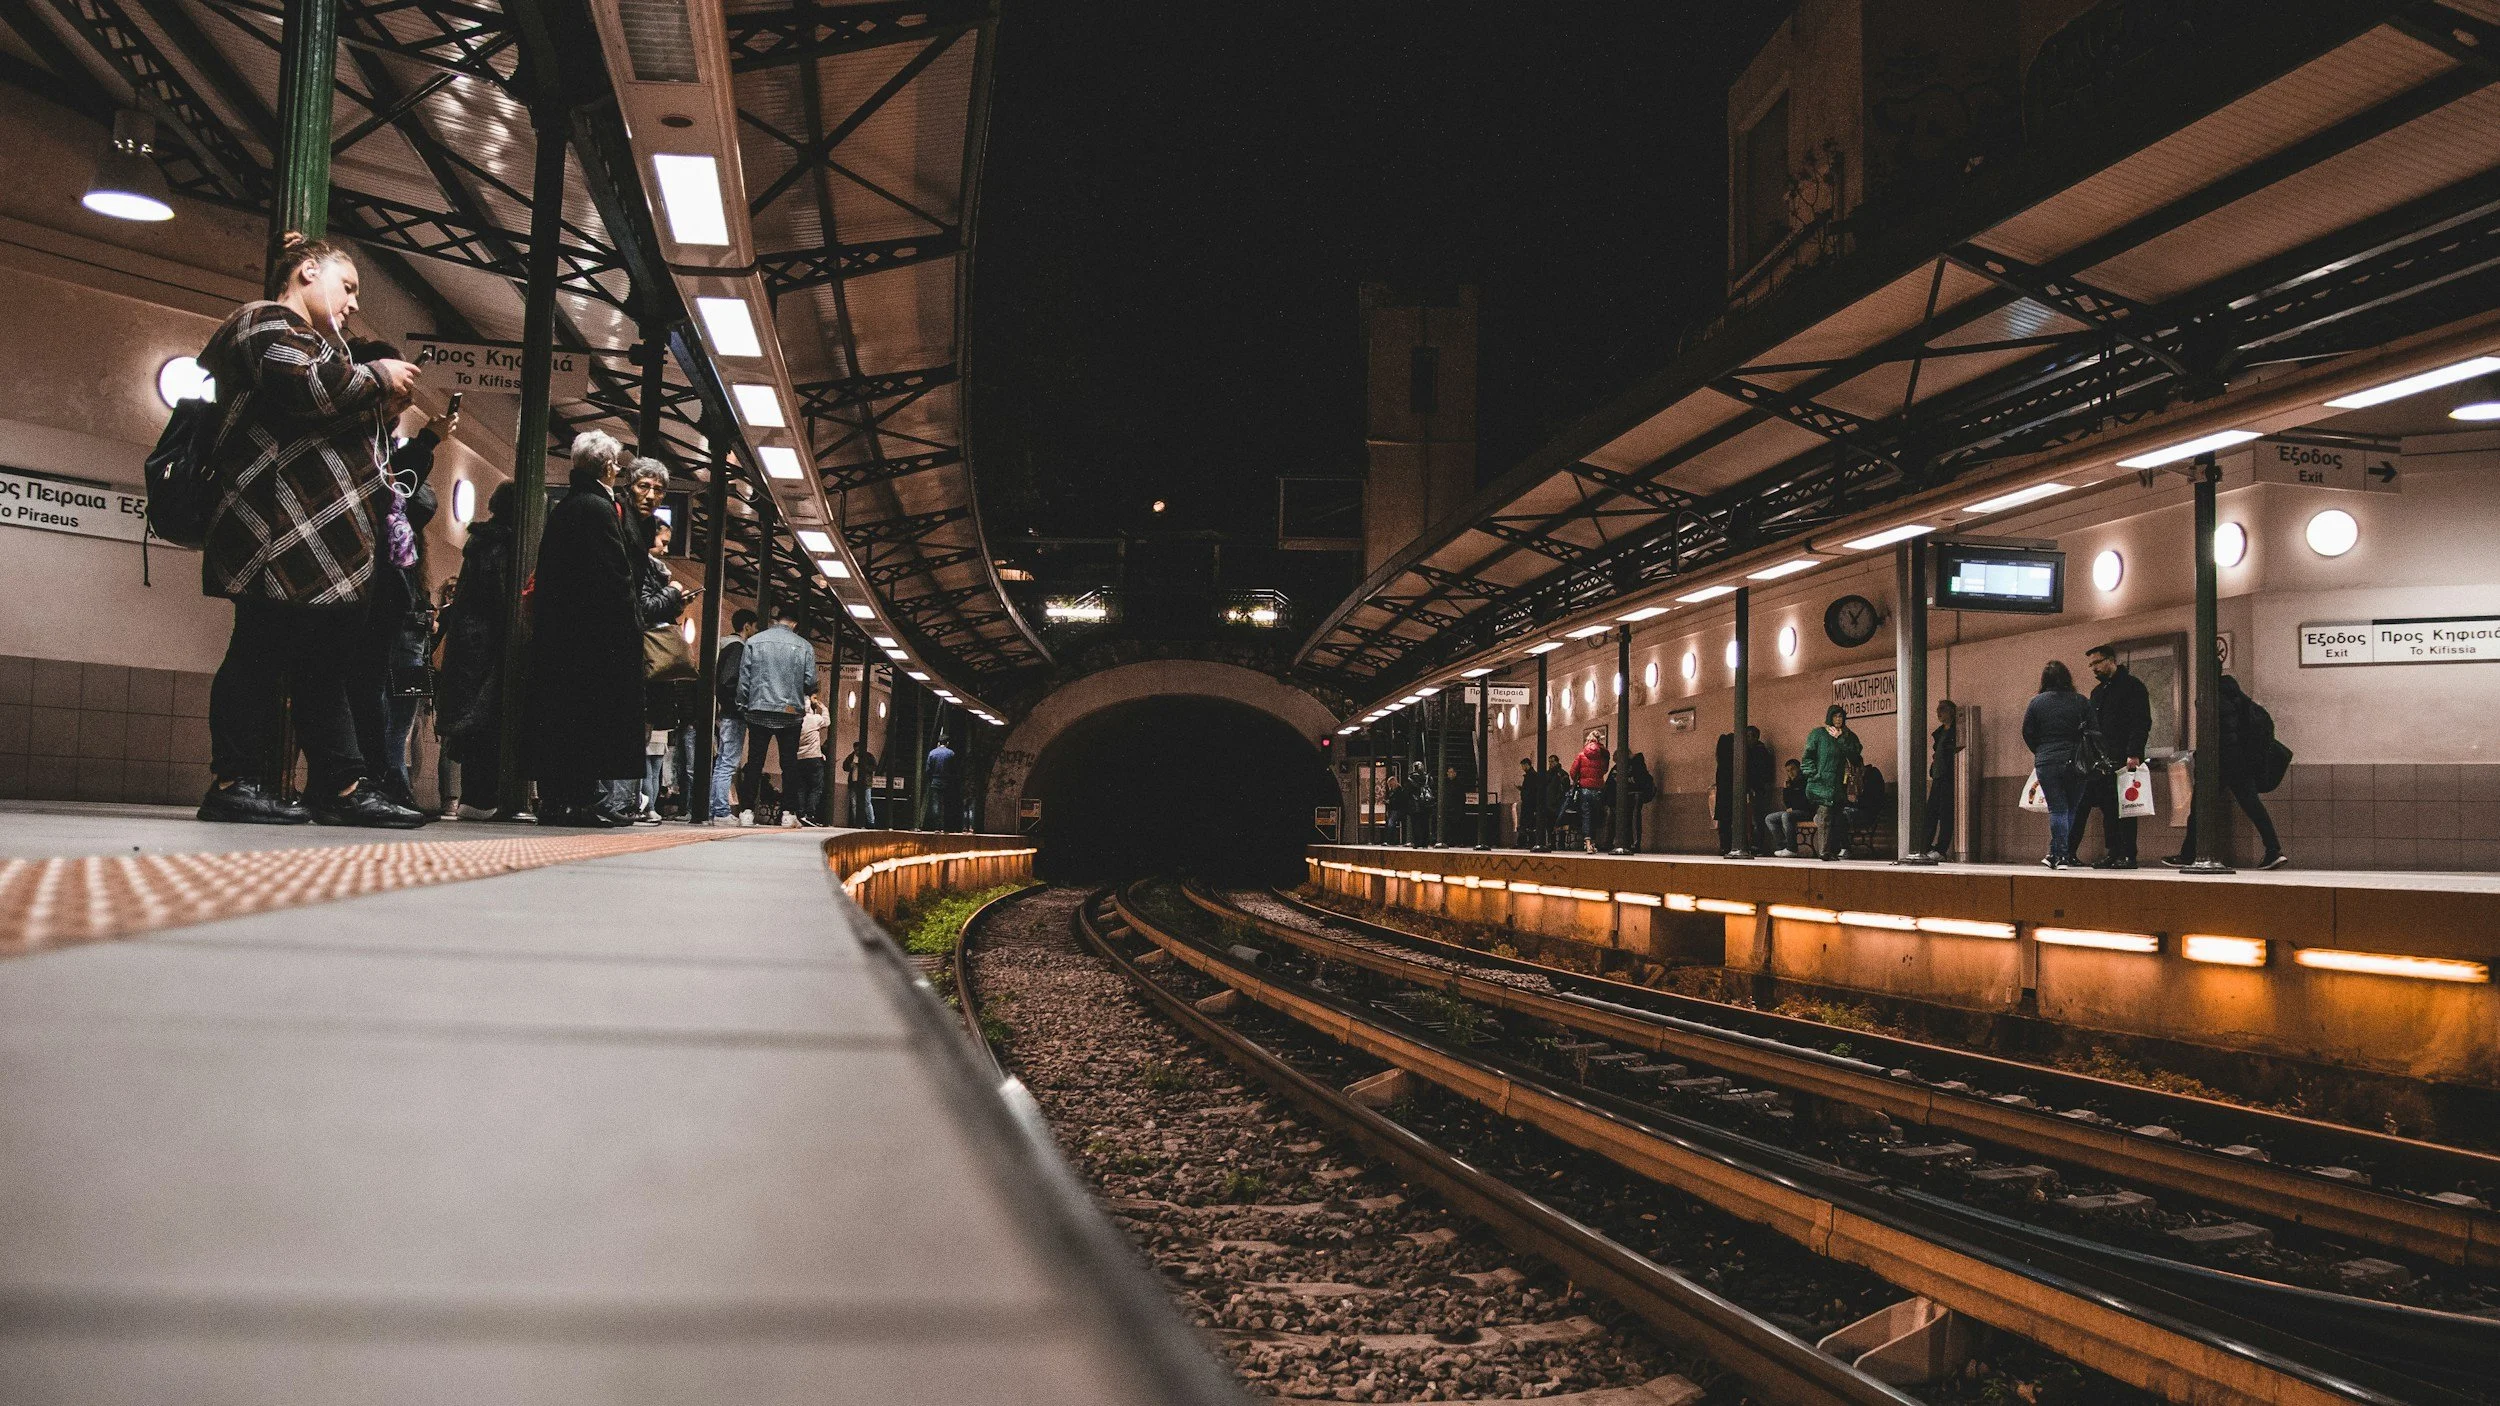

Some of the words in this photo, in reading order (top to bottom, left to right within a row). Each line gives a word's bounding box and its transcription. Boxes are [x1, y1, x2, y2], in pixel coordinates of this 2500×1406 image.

[422, 344, 475, 367] Προς
[486, 349, 573, 372] Κηιά
[455, 372, 472, 385] To
[479, 373, 522, 389] Kifiss
[2276, 445, 2343, 469] Έξοδος
[2299, 470, 2324, 483] Exit
[27, 481, 106, 509] Πειραια
[17, 506, 79, 528] Piraeus
[2305, 632, 2366, 647] Έξοδος
[2381, 630, 2424, 643] Προς
[2325, 648, 2348, 658] Exit
[2410, 646, 2424, 655] To
[2429, 644, 2476, 655] Kifissia
[1834, 674, 1895, 702] ΜΟΝΑΣΤΗΡΙΟΝ
